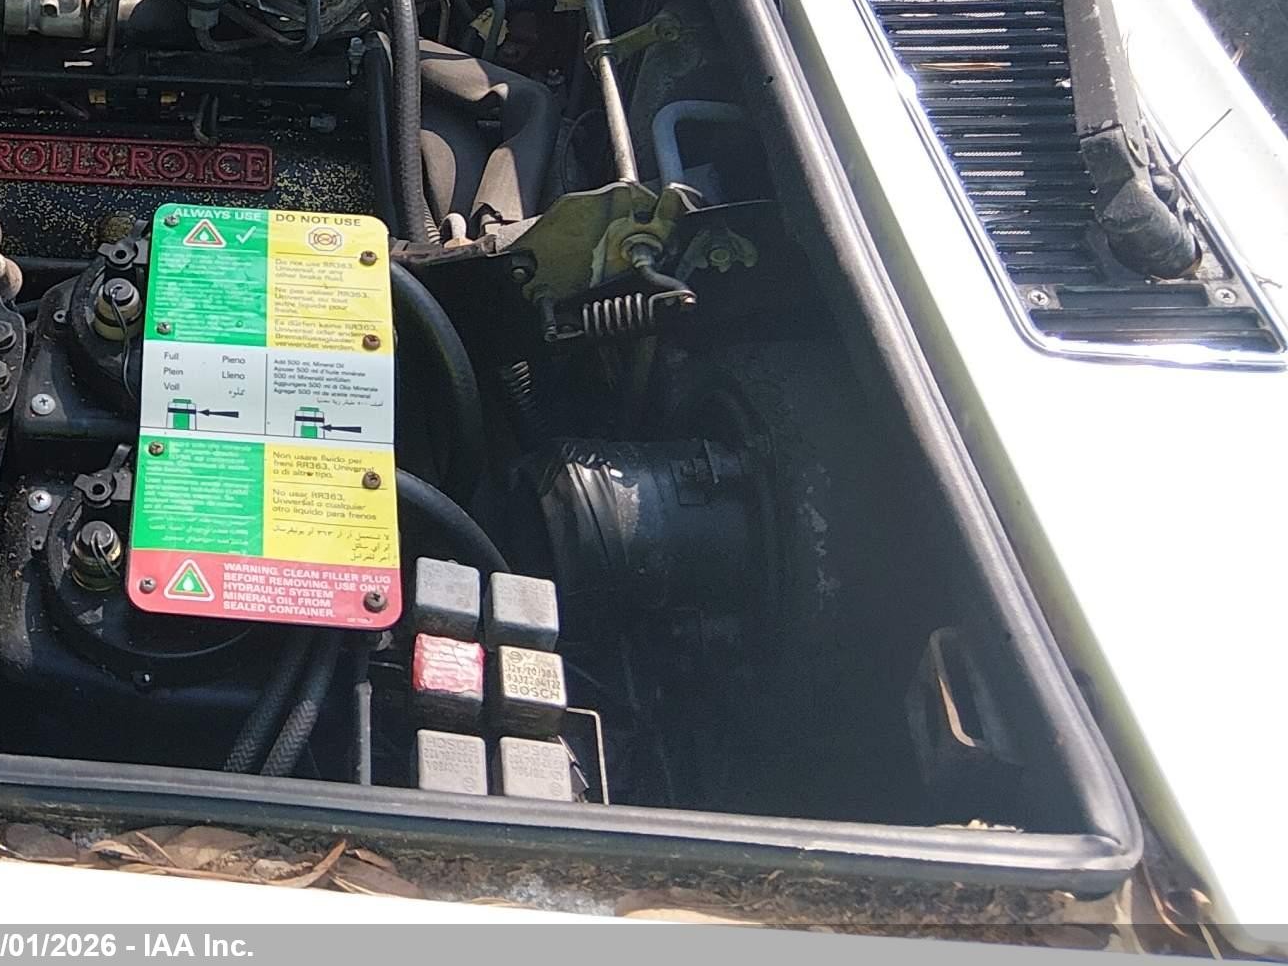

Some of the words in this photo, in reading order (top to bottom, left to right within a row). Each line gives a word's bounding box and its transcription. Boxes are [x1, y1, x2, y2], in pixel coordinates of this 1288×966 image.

[173, 208, 231, 219] ALWAYS
[235, 212, 262, 220] USE
[275, 214, 296, 223] DO
[301, 215, 330, 225] NOT
[334, 217, 361, 226] USE
[164, 352, 179, 360] Full
[163, 368, 184, 376] Plein
[222, 371, 245, 380] Lleno
[163, 382, 180, 391] Voll
[325, 502, 366, 510] cualquier
[349, 512, 376, 520] frenos
[283, 568, 320, 579] CLEAN
[322, 572, 358, 582] FILLER
[362, 575, 391, 584] PLUG
[224, 572, 265, 583] BEFORE
[334, 582, 357, 592] USE
[360, 584, 389, 593] ONLY
[224, 582, 286, 595] HYDRAULIC
[289, 588, 334, 598] SYSTEM
[223, 591, 272, 604] MINERAL
[276, 596, 294, 605] OIL
[298, 598, 331, 608] FROM
[224, 601, 265, 612] SEALED
[269, 605, 336, 617] CONTAINER.
[510, 685, 560, 700] BOSCH
